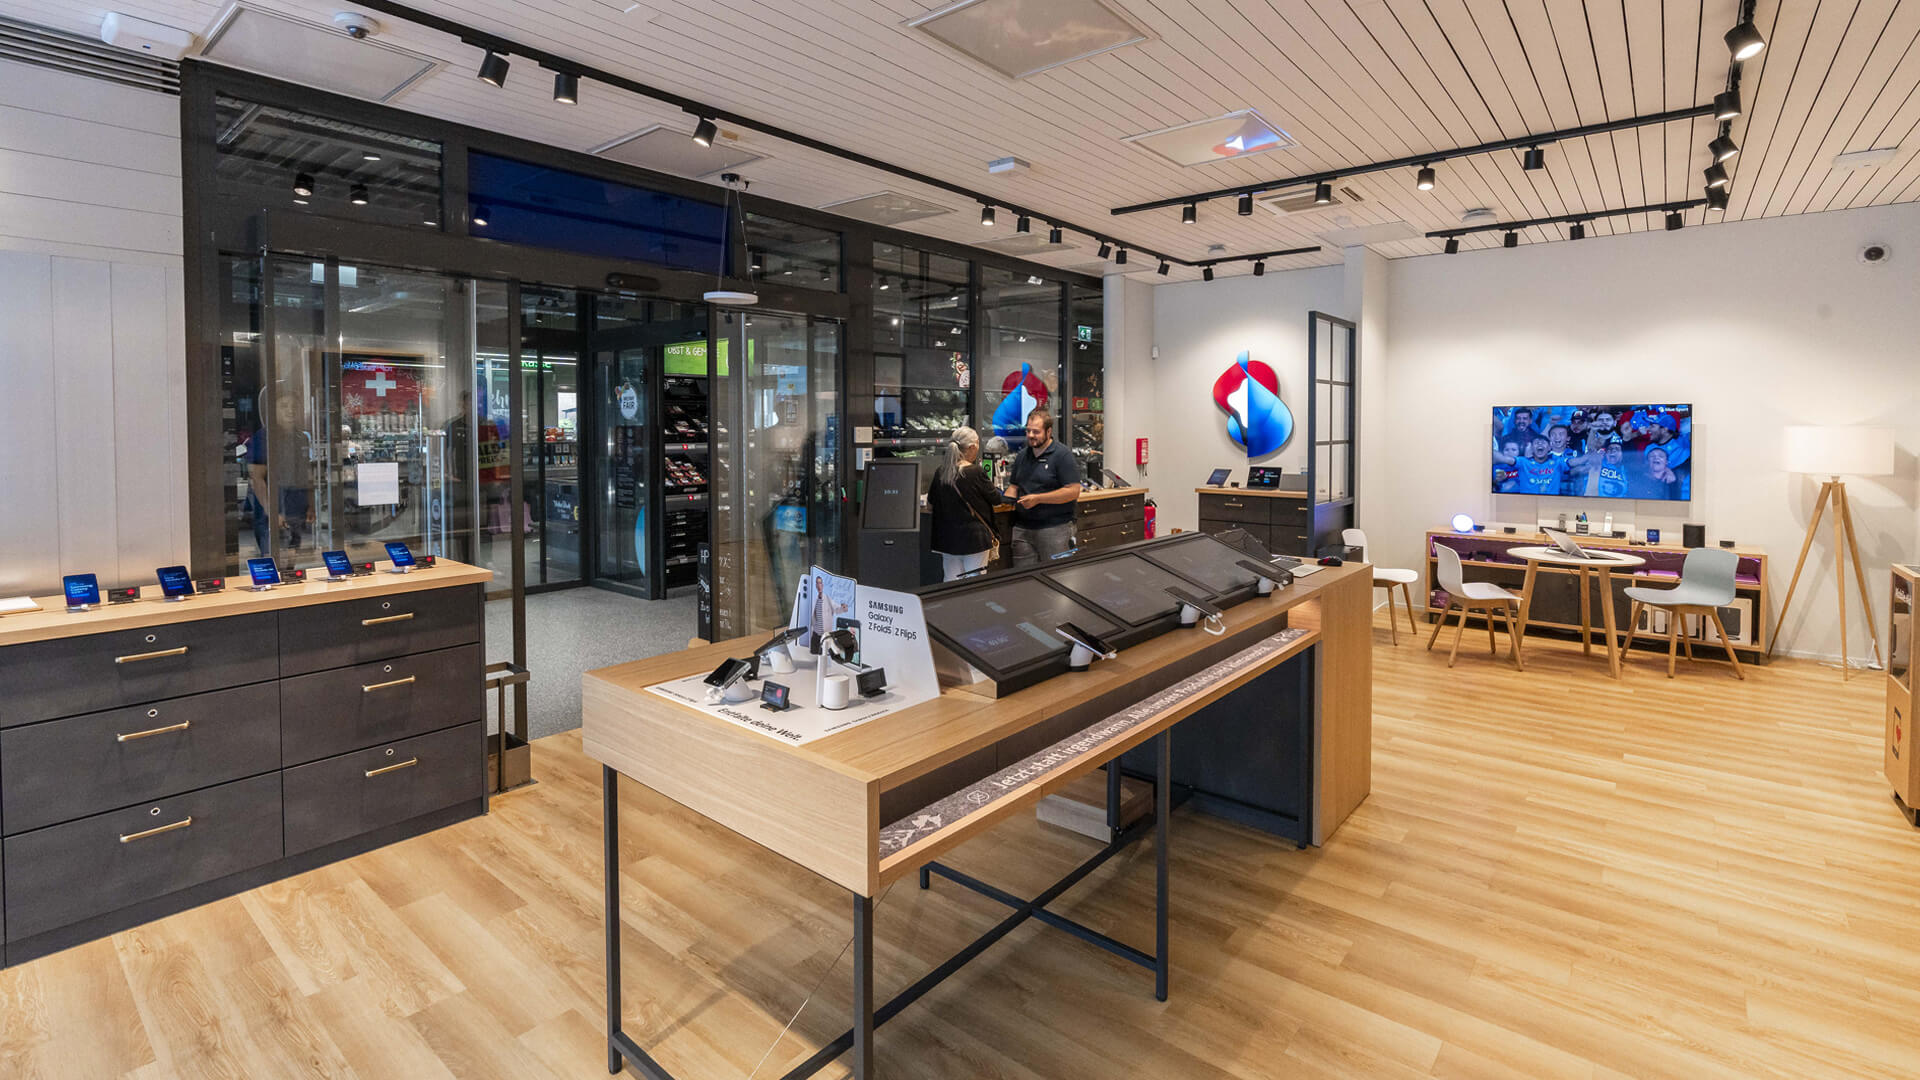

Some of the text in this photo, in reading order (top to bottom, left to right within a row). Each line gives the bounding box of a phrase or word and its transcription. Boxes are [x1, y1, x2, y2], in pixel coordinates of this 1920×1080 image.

[868, 600, 904, 614] SAMSUNG
[868, 612, 894, 625] Galaxy
[868, 622, 917, 641] Z Fold5 Z Flip5
[992, 767, 1034, 790] Jetzt
[1031, 753, 1063, 772] statt
[1060, 717, 1135, 753] irgendwann.
